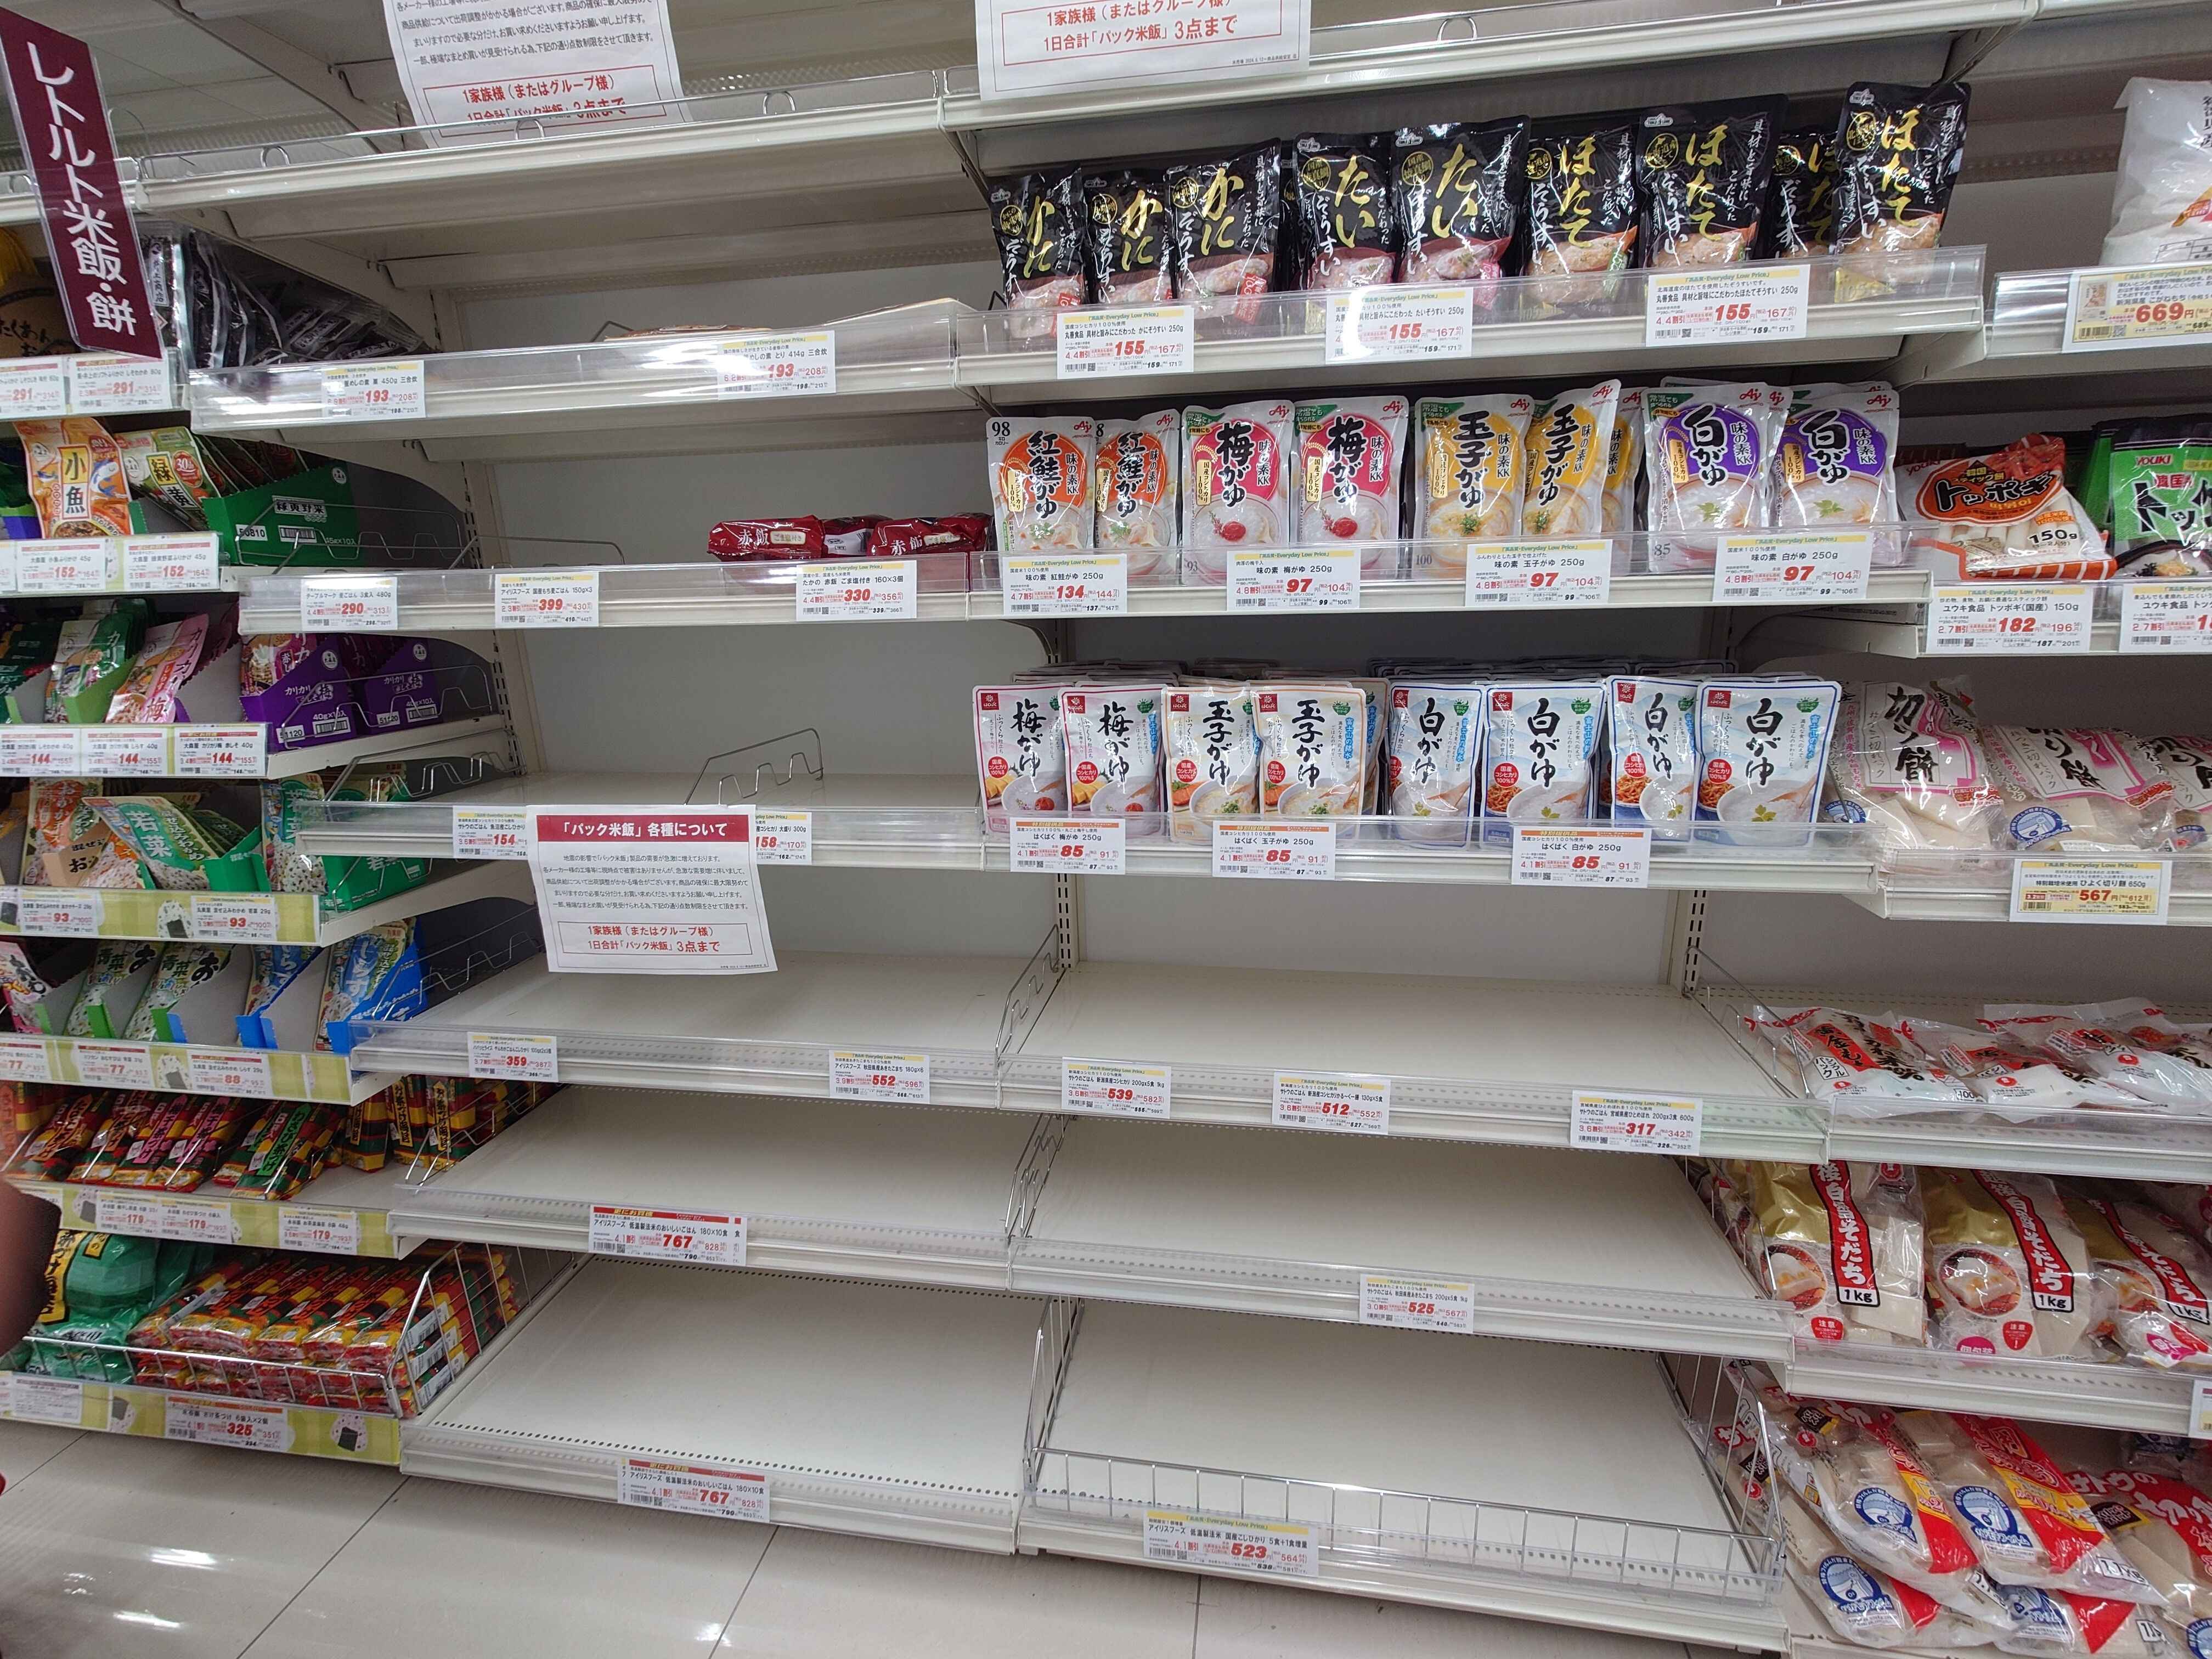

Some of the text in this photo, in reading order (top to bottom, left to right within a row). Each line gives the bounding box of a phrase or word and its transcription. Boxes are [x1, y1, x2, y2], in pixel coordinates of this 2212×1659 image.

[1175, 14, 1238, 40] 3点まで
[1880, 108, 1921, 228] ほたて
[27, 41, 137, 335] レトルト米飯・餅
[1685, 123, 1728, 242] ほたて
[1431, 143, 1478, 239] たい
[1558, 136, 1597, 249] ほたて
[1335, 155, 1375, 248] たい
[1200, 167, 1244, 256] かに
[1024, 195, 1055, 278] かに
[1121, 190, 1163, 271] かに
[1316, 195, 1341, 276] ぞうすい
[1416, 307, 1464, 317] たいぞうすい 250g
[1715, 303, 1751, 321] 155
[2136, 302, 2184, 323] 669
[1065, 330, 1084, 339] 丸善食品
[1086, 328, 1136, 338] 具材と旨みにこだわった
[1138, 325, 1166, 334] かにぞうすい
[1390, 323, 1422, 339] 155
[809, 348, 827, 357] 三合炊
[1115, 340, 1145, 356] 155
[768, 363, 794, 378] 193
[113, 382, 134, 394] 291
[366, 390, 389, 403] 193
[992, 421, 1011, 437] 98
[1684, 403, 1729, 488] 白がゆ
[1801, 408, 1851, 488] 白がゆ
[1328, 416, 1367, 504] 梅がゆ
[1453, 410, 1496, 508] 玉子がゆ
[1538, 403, 1579, 506] 玉子がゆ
[2136, 455, 2171, 465] YOUKI
[1216, 422, 1254, 507] 梅がゆ
[64, 450, 86, 514] 小魚
[1028, 431, 1063, 518] 紅鮭がゆ
[739, 529, 770, 548] 赤飯
[2028, 529, 2078, 544] 150g
[1654, 543, 1671, 556] 85
[1751, 551, 1838, 561] 味の素 白がゆ 250g
[163, 565, 184, 577] 152
[1523, 560, 1555, 568] 玉子がゆ
[55, 567, 75, 578] 152
[1530, 572, 1559, 587] 97
[1784, 566, 1815, 582] 97
[1057, 585, 1084, 599] 134
[1286, 578, 1312, 592] 97
[844, 589, 871, 602] 330
[342, 603, 364, 614] 290
[539, 599, 563, 611] 399
[2054, 603, 2079, 611] 150g
[1999, 617, 2036, 633] 182
[1010, 698, 1047, 777] 梅がゆ
[1097, 701, 1133, 783] 梅がゆ
[1203, 700, 1235, 785] 玉子がゆ
[1292, 699, 1325, 788] 玉子がゆ
[1528, 697, 1560, 788] 白がゆ
[1645, 693, 1673, 779] 白がゆ
[1746, 698, 1784, 786] 白がゆ
[119, 753, 139, 764] 144
[212, 753, 233, 764] 144
[647, 822, 728, 837] 各種について
[494, 834, 515, 845] 154
[1060, 845, 1084, 857] 85
[1266, 850, 1291, 862] 85
[1572, 856, 1600, 869] 85
[2079, 890, 2111, 901] 567
[229, 917, 247, 928] 93
[677, 940, 720, 952] 3点まで
[506, 1056, 527, 1066] 359
[224, 1075, 241, 1085] 88
[872, 1074, 896, 1086] 552
[1108, 1088, 1133, 1101] 539
[1322, 1102, 1350, 1115] 512
[1626, 1122, 1656, 1136] 317
[312, 1230, 330, 1240] 179
[663, 1234, 692, 1249] 767
[1844, 1288, 1872, 1303] 1kg
[2038, 1294, 2066, 1308] 1kg
[1408, 1302, 1435, 1314] 525
[700, 1489, 730, 1504] 767
[1231, 1543, 1267, 1559] 523
